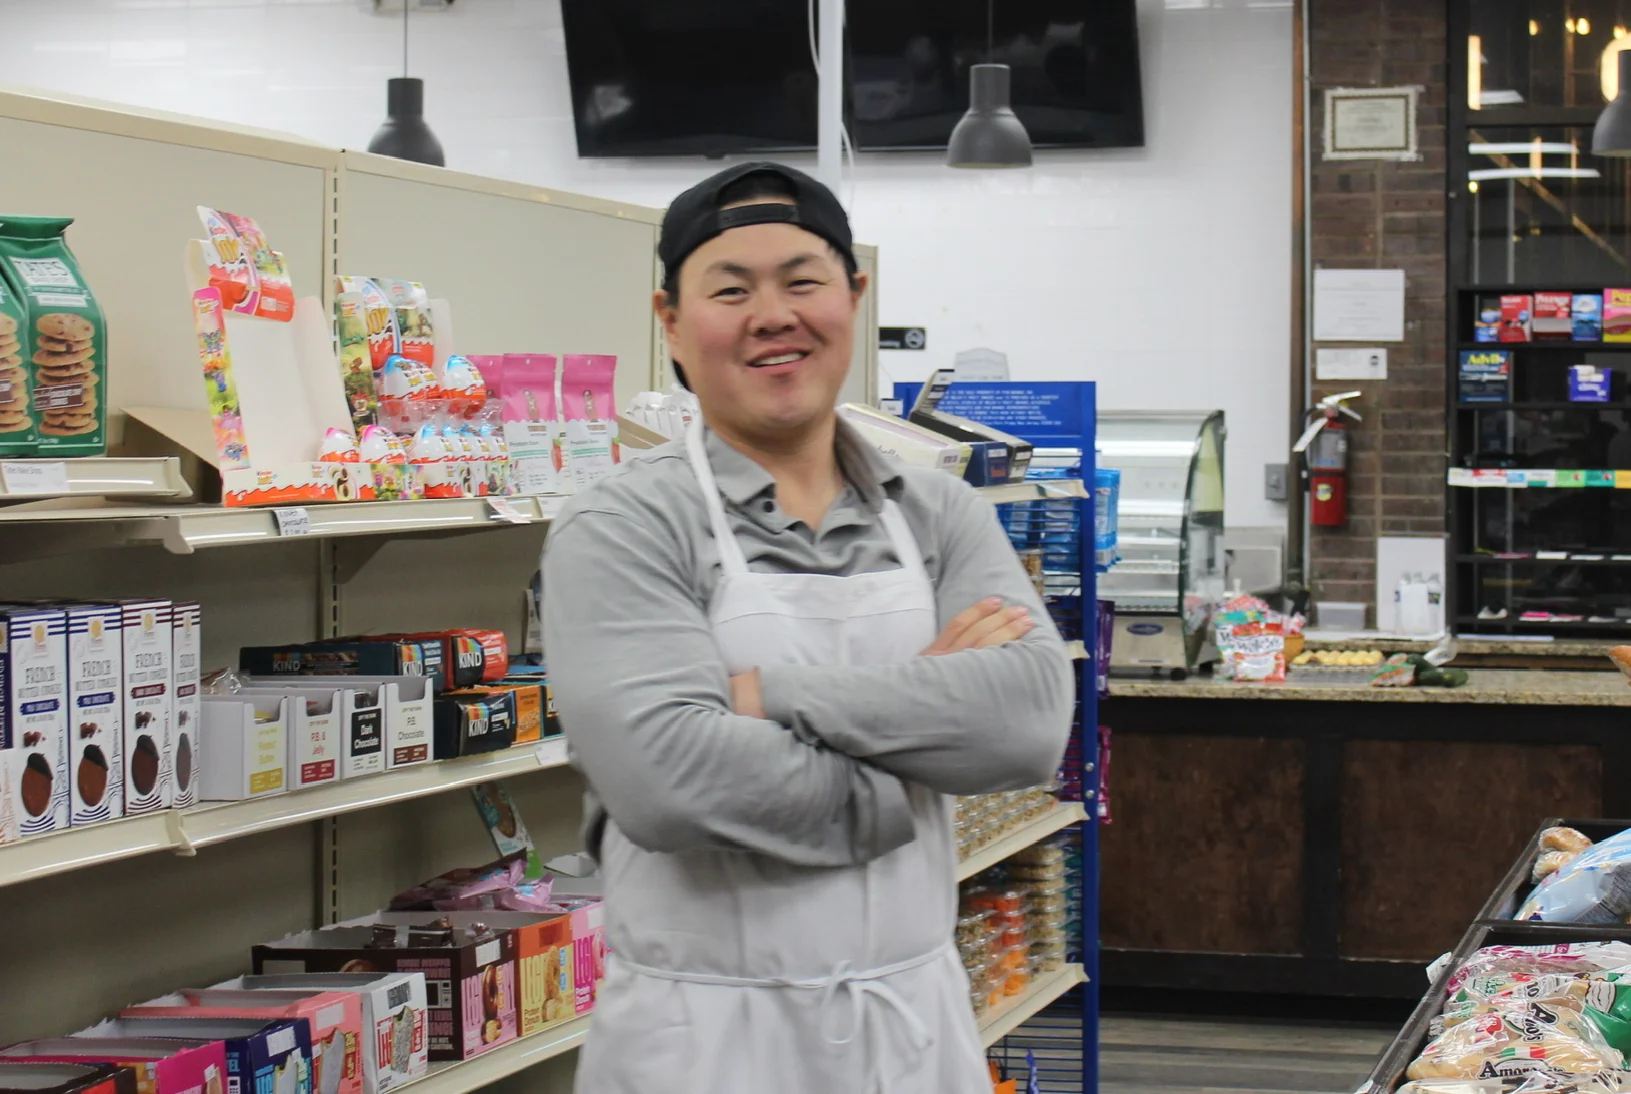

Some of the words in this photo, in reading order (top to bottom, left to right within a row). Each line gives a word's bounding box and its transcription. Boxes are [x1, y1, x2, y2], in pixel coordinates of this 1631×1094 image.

[273, 659, 300, 672] KIND
[458, 651, 482, 669] KIND
[402, 661, 423, 676] KIND
[468, 718, 489, 738] KIND
[354, 736, 380, 749] Chocolate
[398, 730, 425, 741] Chocolate
